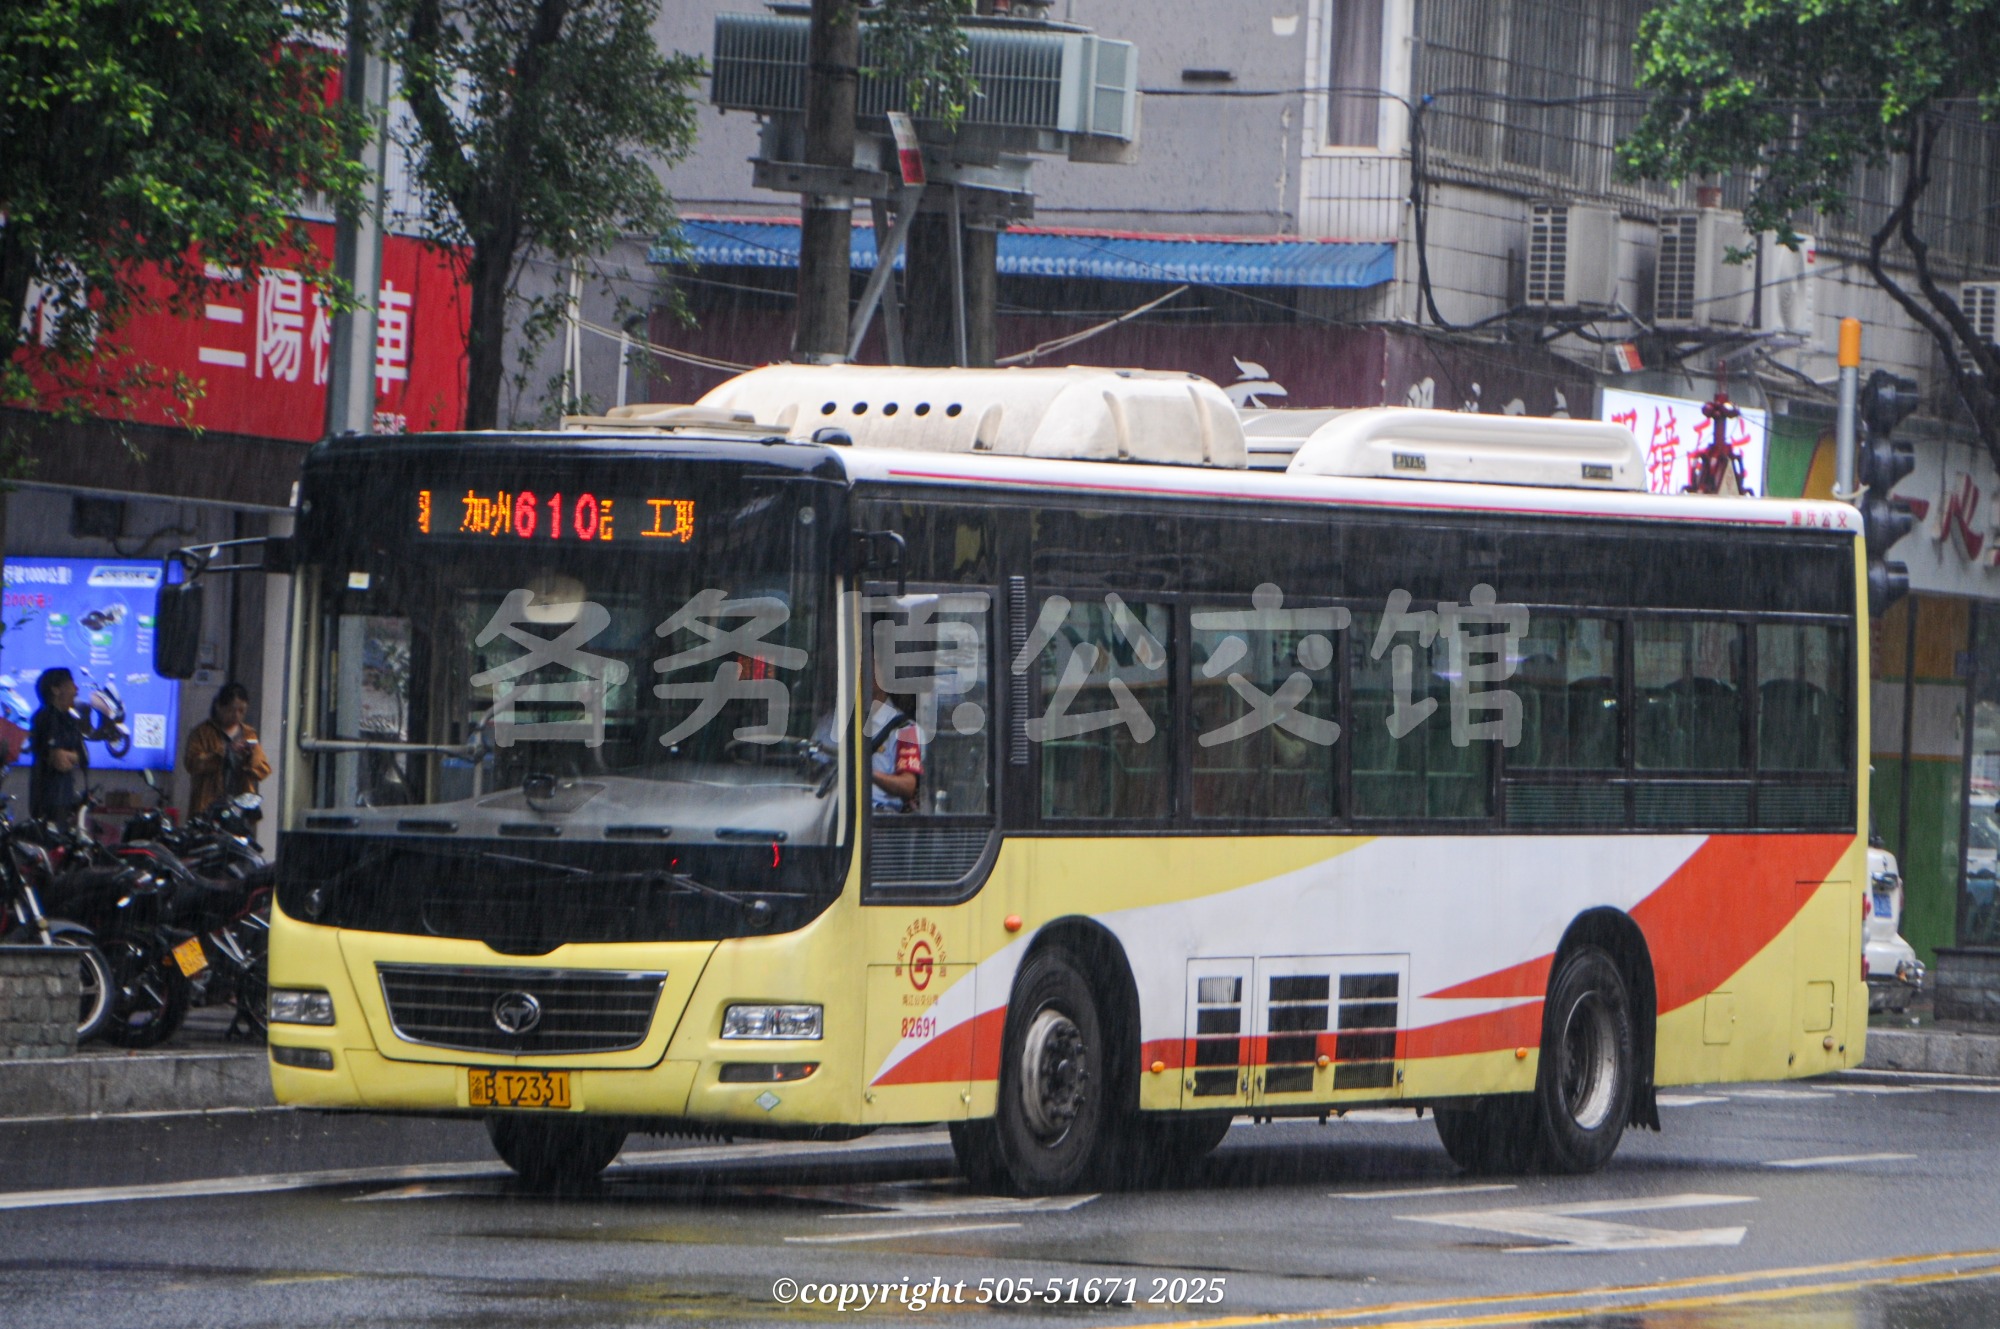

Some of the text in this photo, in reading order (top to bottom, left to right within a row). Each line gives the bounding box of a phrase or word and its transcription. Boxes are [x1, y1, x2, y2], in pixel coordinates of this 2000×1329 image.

[514, 491, 599, 540] 610
[1791, 509, 1848, 528] 重庆公交
[901, 1016, 936, 1038] 82691
